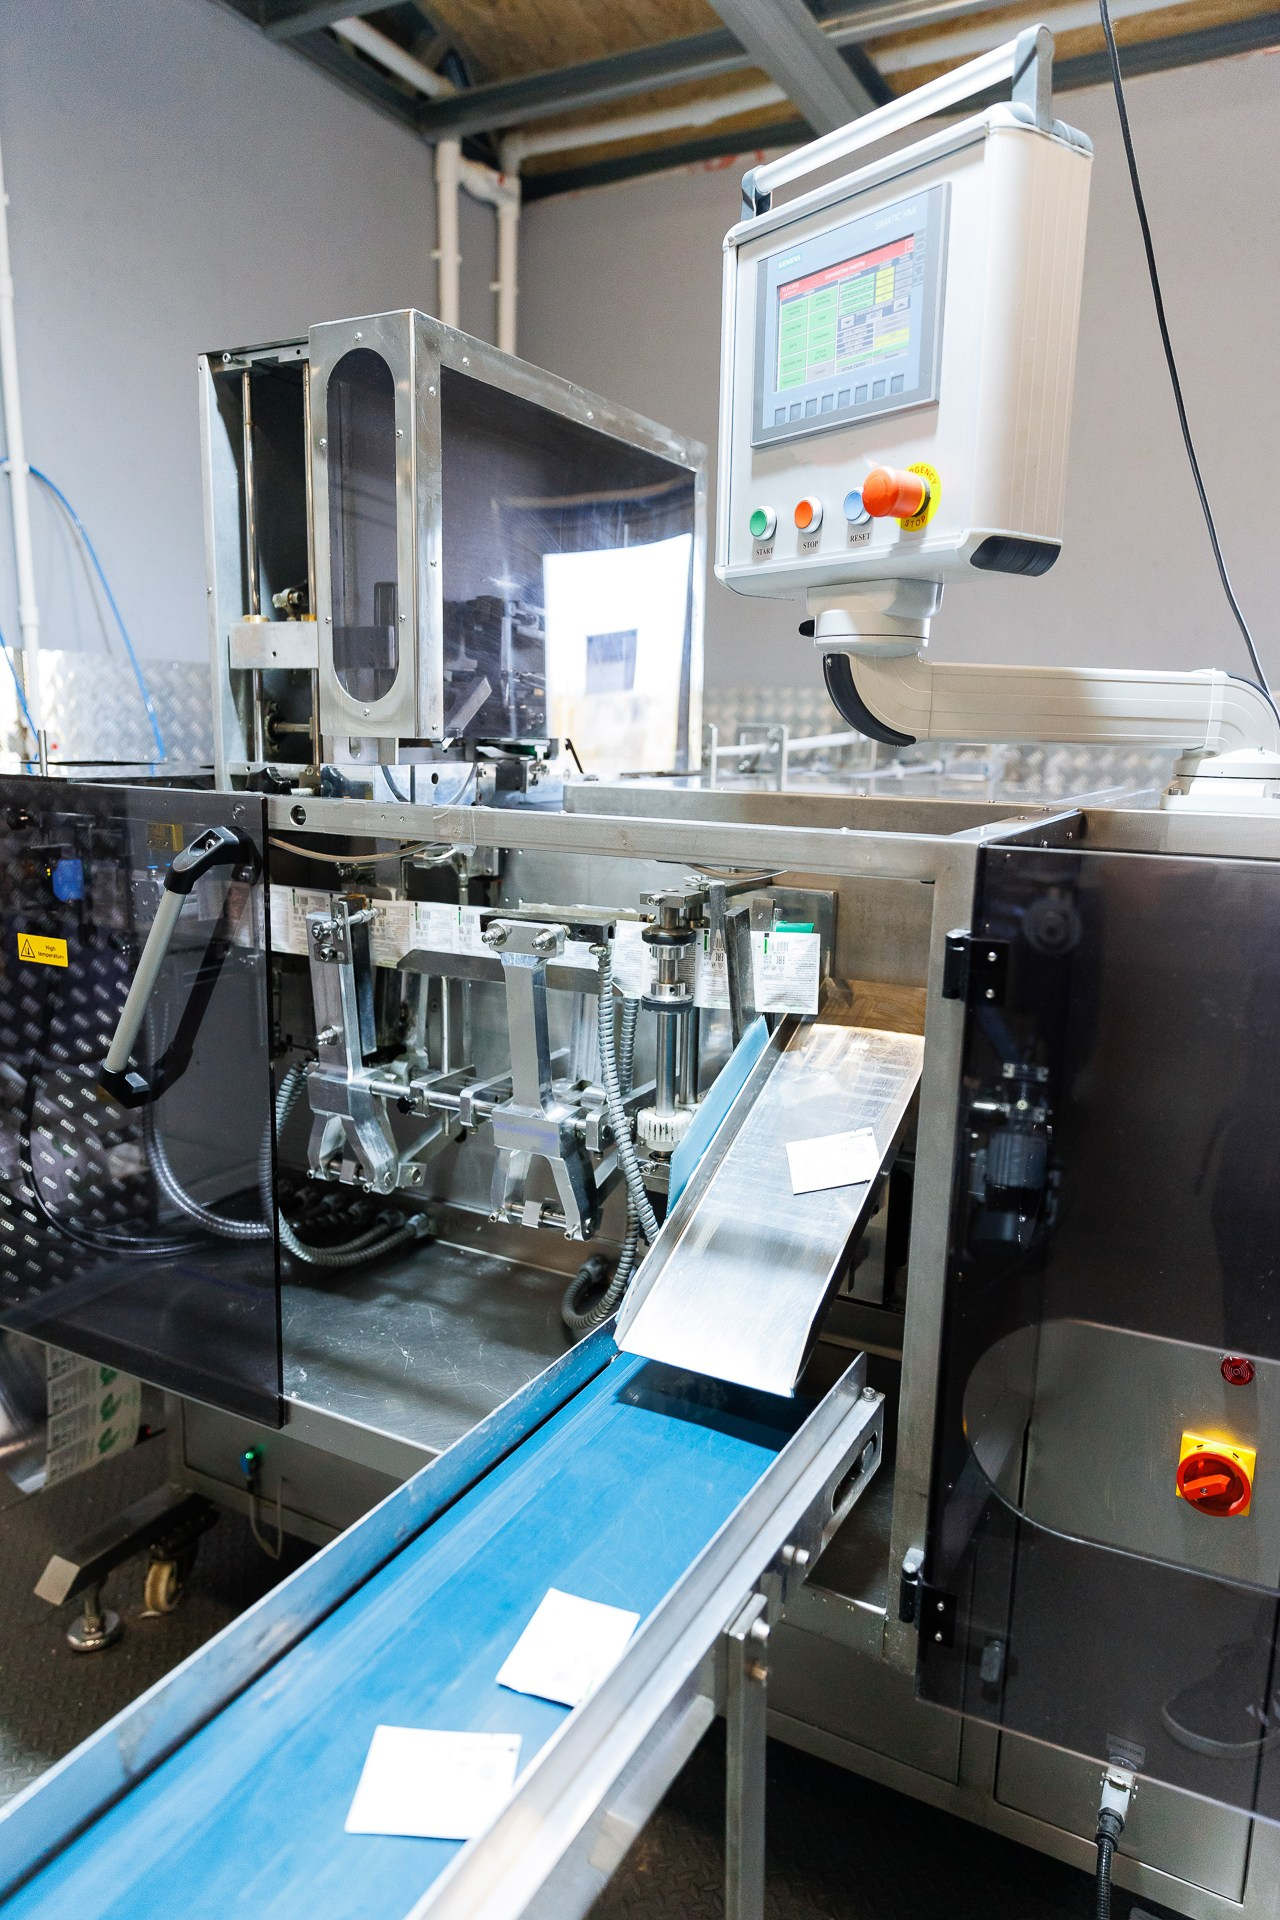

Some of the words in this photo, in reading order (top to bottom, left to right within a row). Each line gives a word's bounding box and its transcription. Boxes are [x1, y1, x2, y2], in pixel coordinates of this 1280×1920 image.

[778, 254, 801, 269] SIEMENS
[912, 230, 927, 286] TOUCH
[904, 515, 926, 527] STOP
[849, 532, 871, 542] RESET
[803, 541, 819, 549] STOP
[756, 547, 774, 556] START
